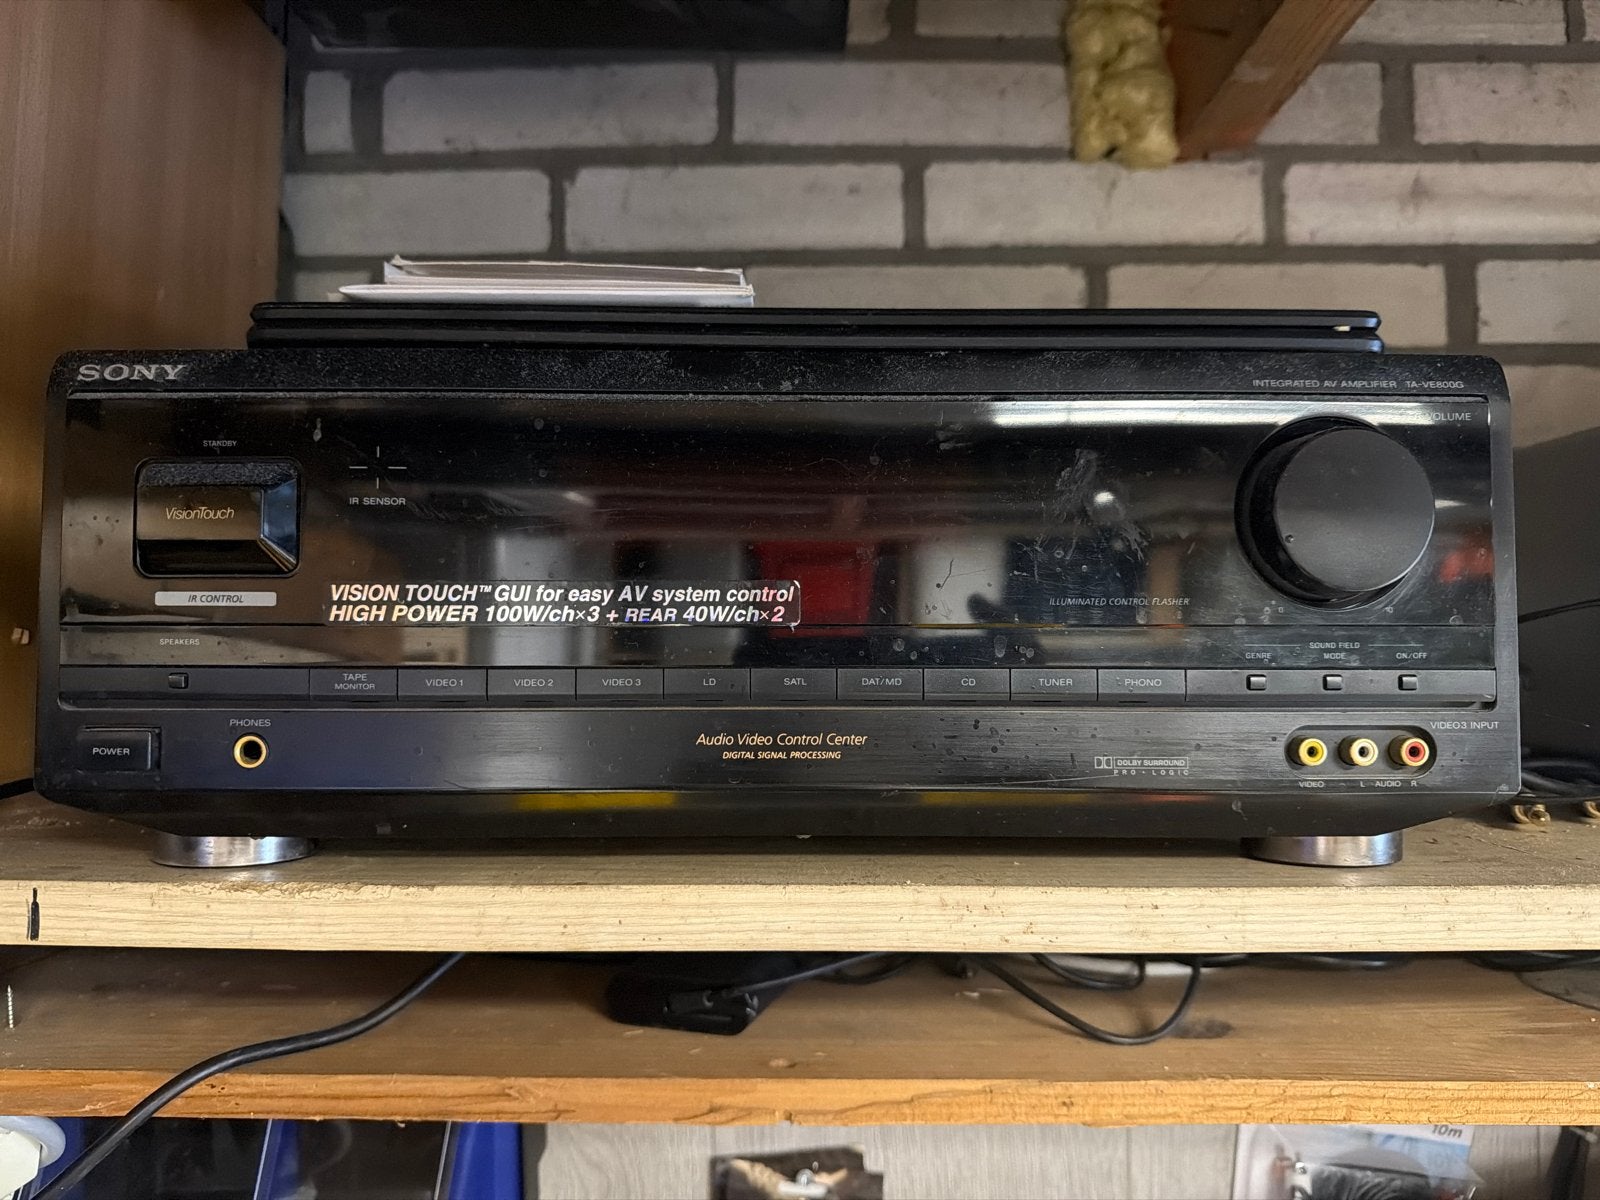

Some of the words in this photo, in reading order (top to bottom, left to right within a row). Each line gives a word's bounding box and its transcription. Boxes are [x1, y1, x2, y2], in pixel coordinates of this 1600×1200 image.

[76, 363, 187, 382] SONY
[1252, 379, 1320, 389] INTEGRATED
[1323, 380, 1338, 389] AV
[1340, 380, 1398, 389] AMPLIFIER
[1405, 380, 1465, 389] TA-VE800G
[203, 439, 238, 448] STANDBY
[349, 497, 360, 506] IR
[363, 497, 407, 506] SENSOR
[165, 506, 235, 520] VisionTouch
[187, 594, 198, 604] IR
[199, 594, 245, 604] CONTROL
[330, 583, 399, 601] VISION
[494, 584, 531, 602] GUI
[535, 584, 564, 602] for
[568, 588, 614, 606] easy
[617, 585, 648, 602] AV
[651, 586, 721, 606] system
[726, 586, 795, 602] control
[1050, 597, 1107, 606] ILLUMINATED
[1108, 597, 1150, 606] CONTROL
[1151, 597, 1190, 606] FLASHER
[328, 604, 386, 622] HIGH
[391, 604, 478, 622] POWER
[624, 608, 677, 622] REAR
[159, 638, 200, 646] SPEAKERS
[1309, 641, 1336, 649] SOUND
[1338, 641, 1360, 649] FIELD
[1245, 652, 1272, 660] GENRE
[1323, 652, 1346, 660] MODE
[1395, 652, 1428, 660] ON/OFF
[342, 673, 367, 682] TAPE
[703, 678, 716, 686] LD
[784, 677, 807, 686] SATL
[861, 677, 902, 686] DAT/MD
[961, 678, 976, 686] CD
[425, 679, 457, 687] VIDEO
[458, 679, 464, 687] 1
[513, 679, 546, 687] VIDEO
[547, 679, 554, 687] 2
[602, 678, 634, 687] VIDEO
[635, 678, 642, 687] 3
[1038, 678, 1073, 687] TUNER
[1124, 678, 1162, 687] PHONO
[229, 718, 271, 727] PHONES
[1470, 721, 1500, 730] INPUT
[696, 733, 734, 746] Audio
[737, 733, 773, 746] Video
[776, 733, 823, 746] Control
[826, 733, 868, 746] Center
[92, 747, 130, 756] POWER
[722, 751, 755, 760] DIGITAL
[757, 751, 787, 760] SIGNAL
[789, 751, 842, 760] PROCESSING
[1143, 759, 1186, 767] SURROUND
[1299, 780, 1325, 788] VIDEO
[1360, 780, 1365, 788] L
[1375, 780, 1402, 788] AUDIO
[1410, 780, 1418, 788] R
[1432, 1124, 1463, 1138] 10m
